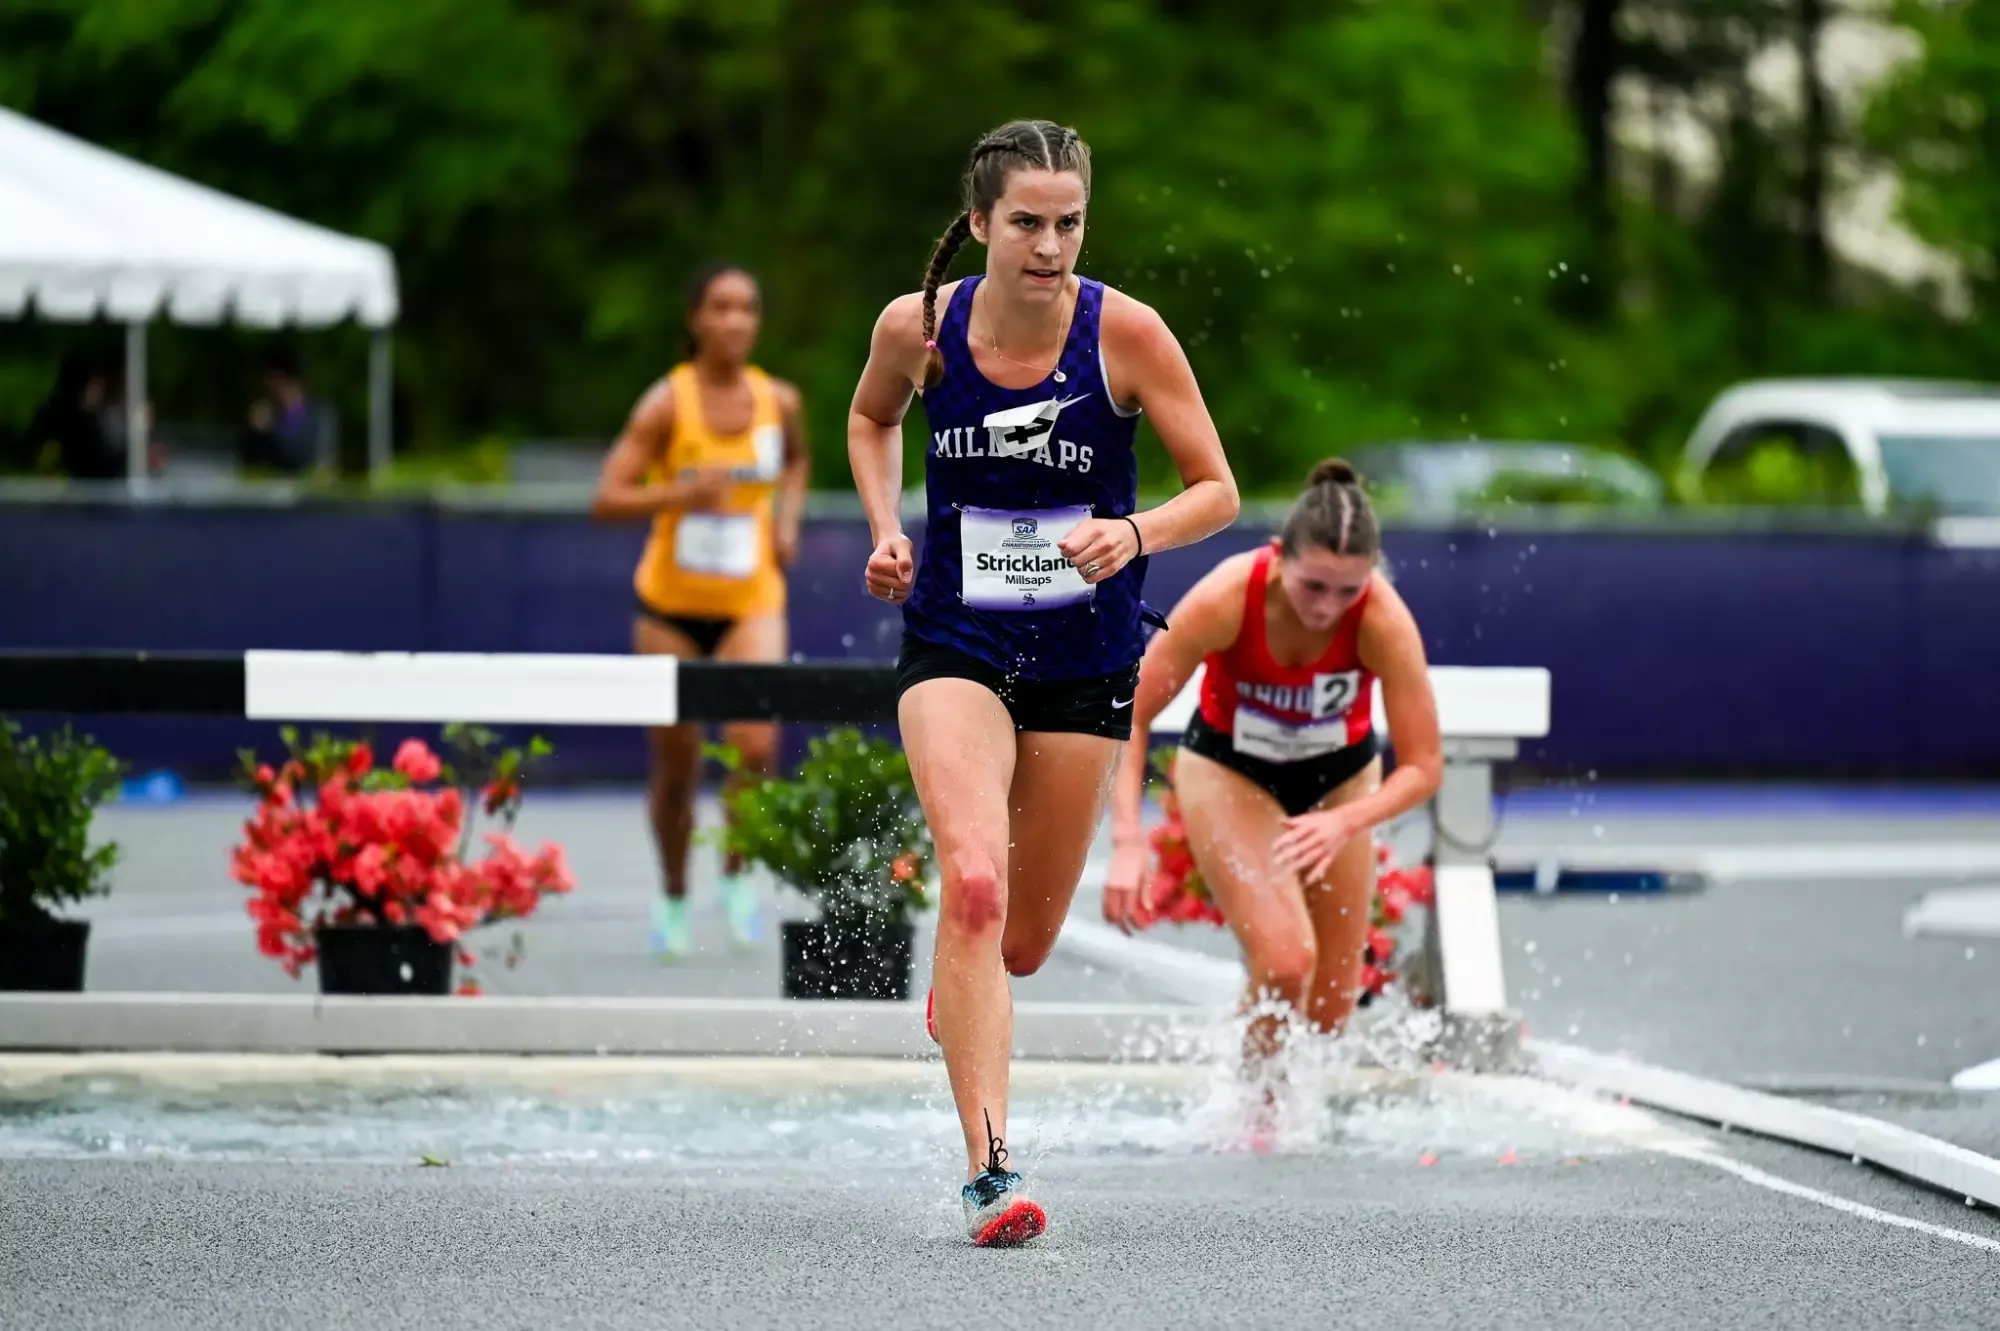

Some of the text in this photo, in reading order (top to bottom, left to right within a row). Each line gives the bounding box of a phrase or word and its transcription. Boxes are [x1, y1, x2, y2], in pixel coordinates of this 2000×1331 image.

[1015, 525, 1036, 534] SAA
[1005, 574, 1052, 586] Millsaps
[1323, 677, 1349, 713] 2
